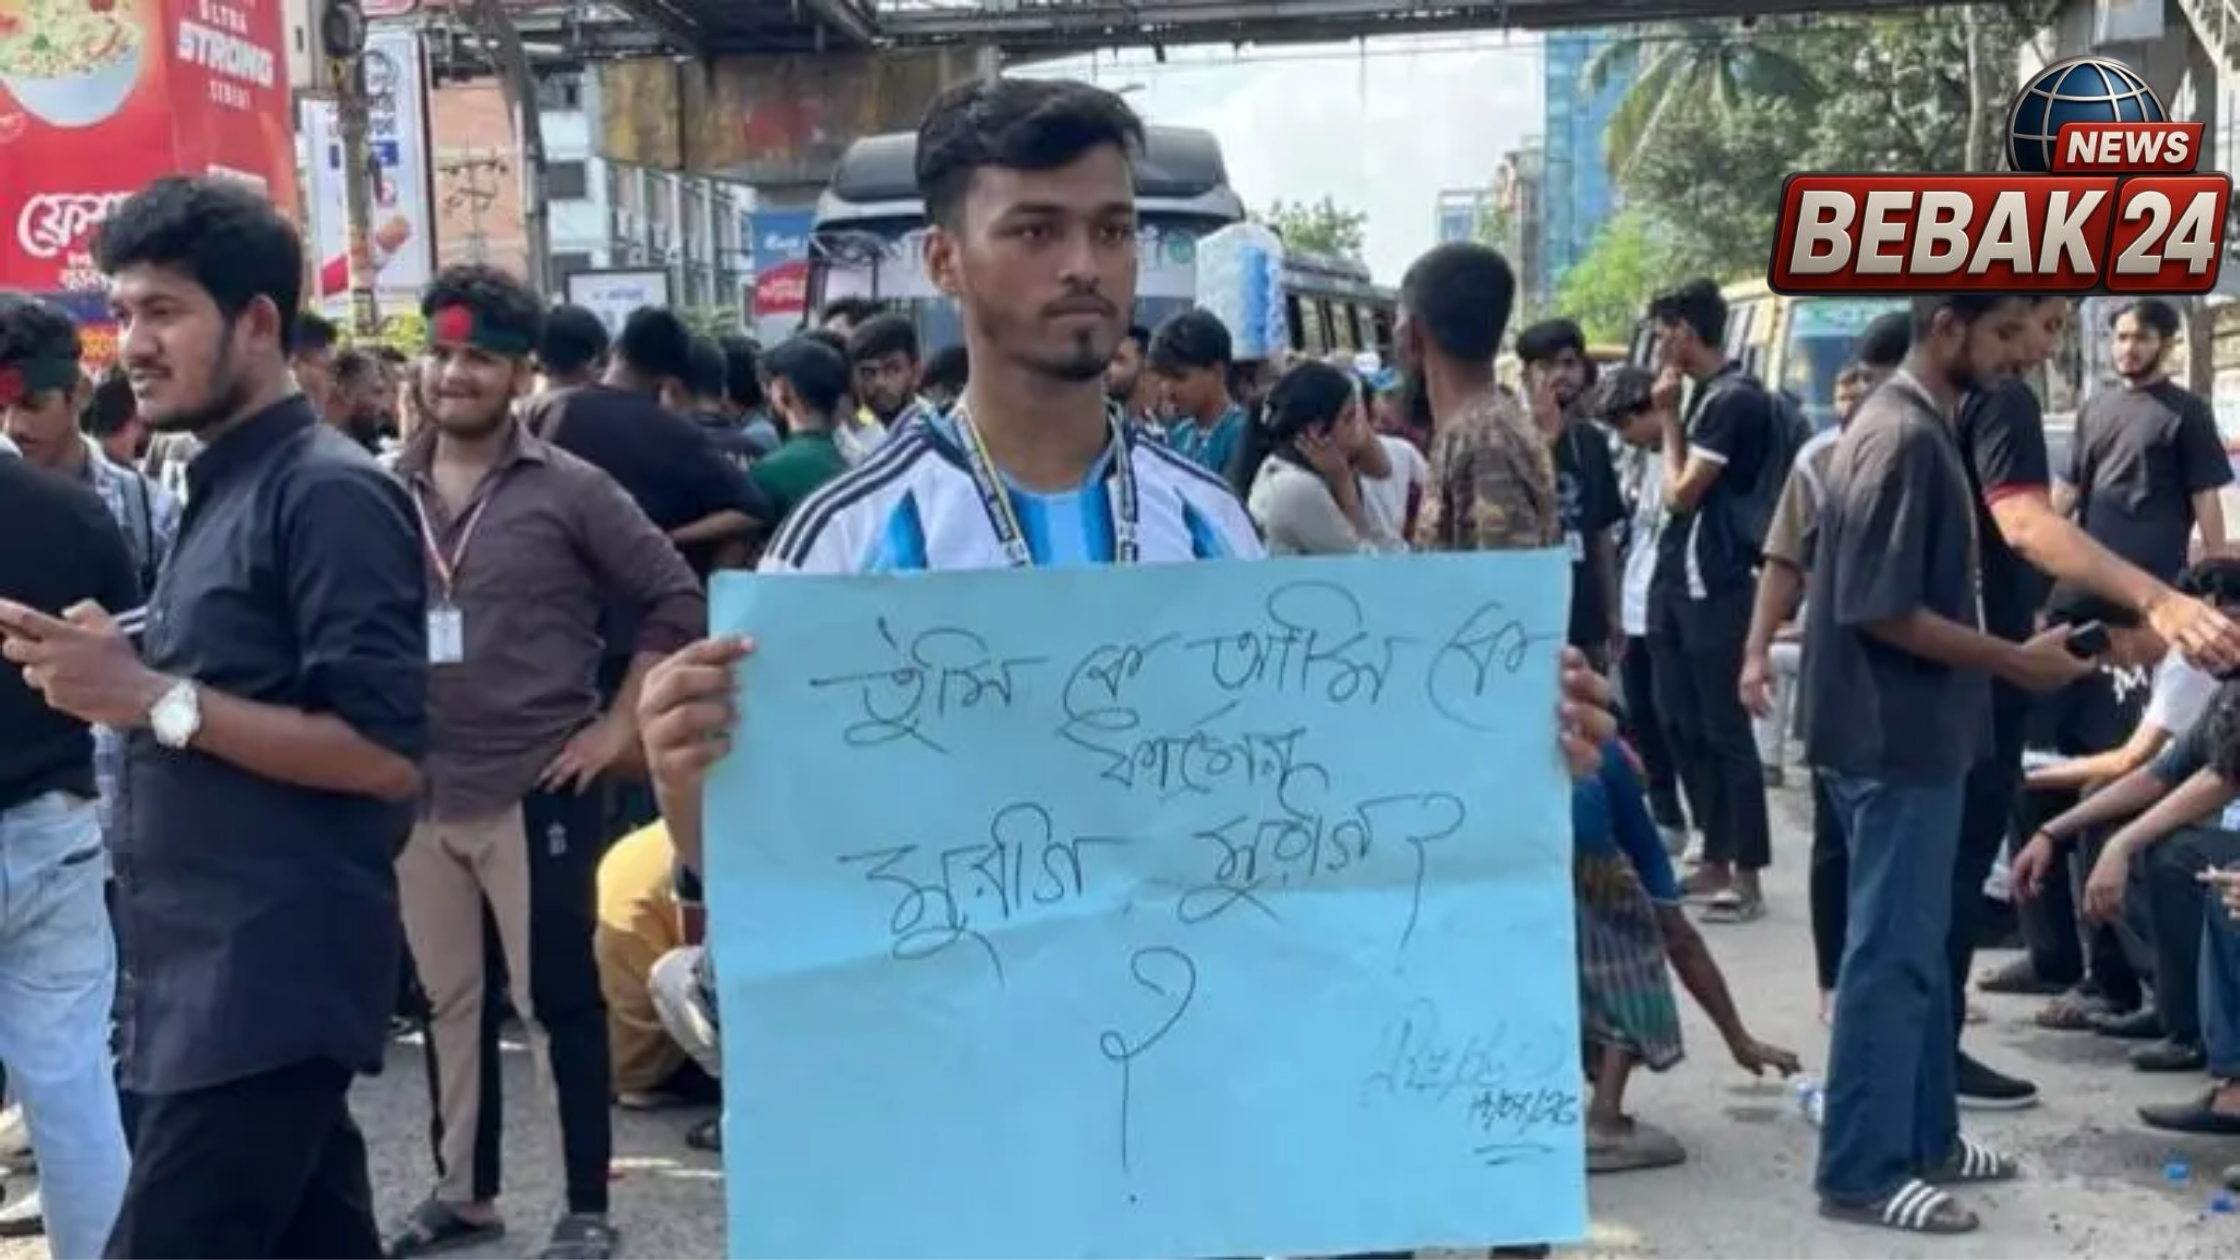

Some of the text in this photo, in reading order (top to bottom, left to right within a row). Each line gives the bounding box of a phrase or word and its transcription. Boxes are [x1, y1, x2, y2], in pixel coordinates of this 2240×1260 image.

[179, 20, 274, 90] STRONG
[808, 580, 1560, 757] তুমি কে আমি কে
[1100, 946, 1197, 1205] ?
